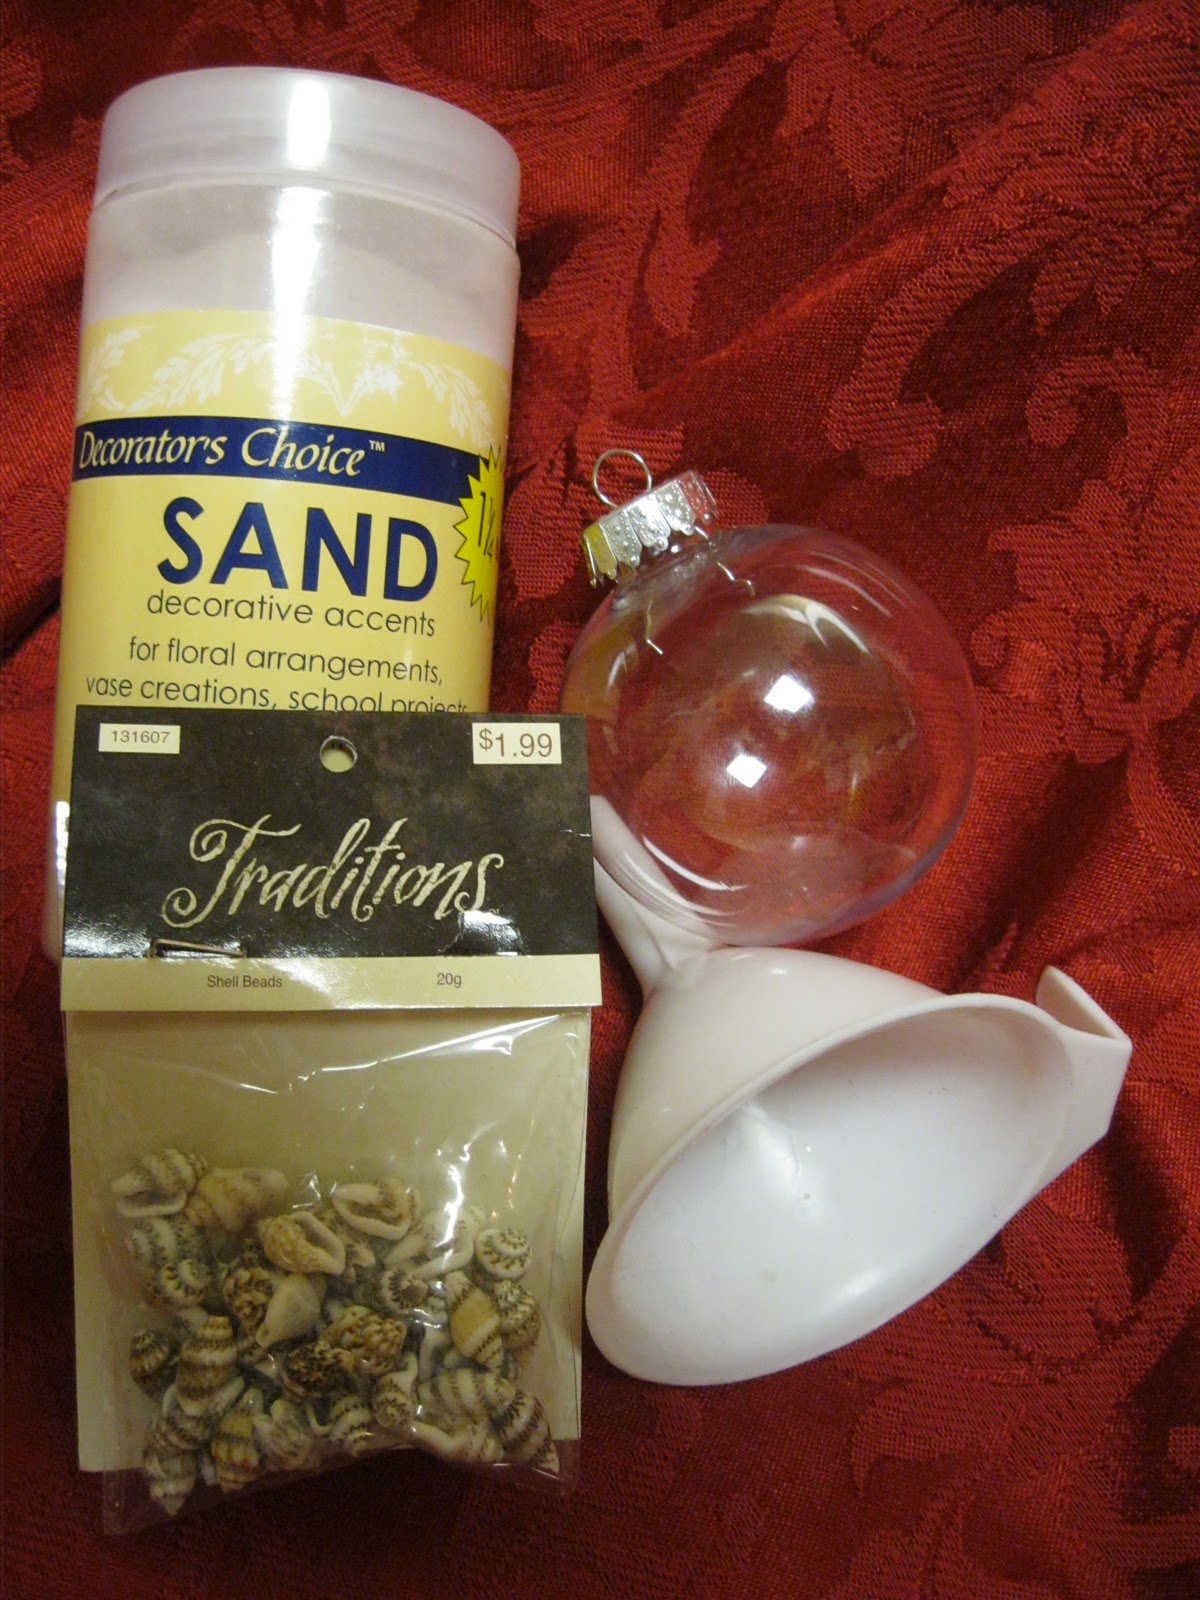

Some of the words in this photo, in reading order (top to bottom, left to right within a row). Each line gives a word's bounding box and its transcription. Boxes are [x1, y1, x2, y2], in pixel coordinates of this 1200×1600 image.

[79, 430, 228, 469] Decorator's
[241, 427, 366, 477] Choice
[157, 497, 439, 602] SAND
[147, 589, 313, 625] decorative
[324, 608, 436, 637] accents
[129, 636, 160, 662] for
[168, 639, 236, 667] floral
[246, 650, 443, 687] arrangements,
[86, 675, 134, 699] vase
[140, 679, 278, 711] creations,
[288, 686, 382, 712] school
[110, 730, 171, 745] 131607
[478, 728, 553, 758] $1.99
[161, 814, 504, 929] Traditions
[207, 975, 239, 990] Shell
[243, 975, 284, 990] Beads
[436, 973, 463, 990] 20g
